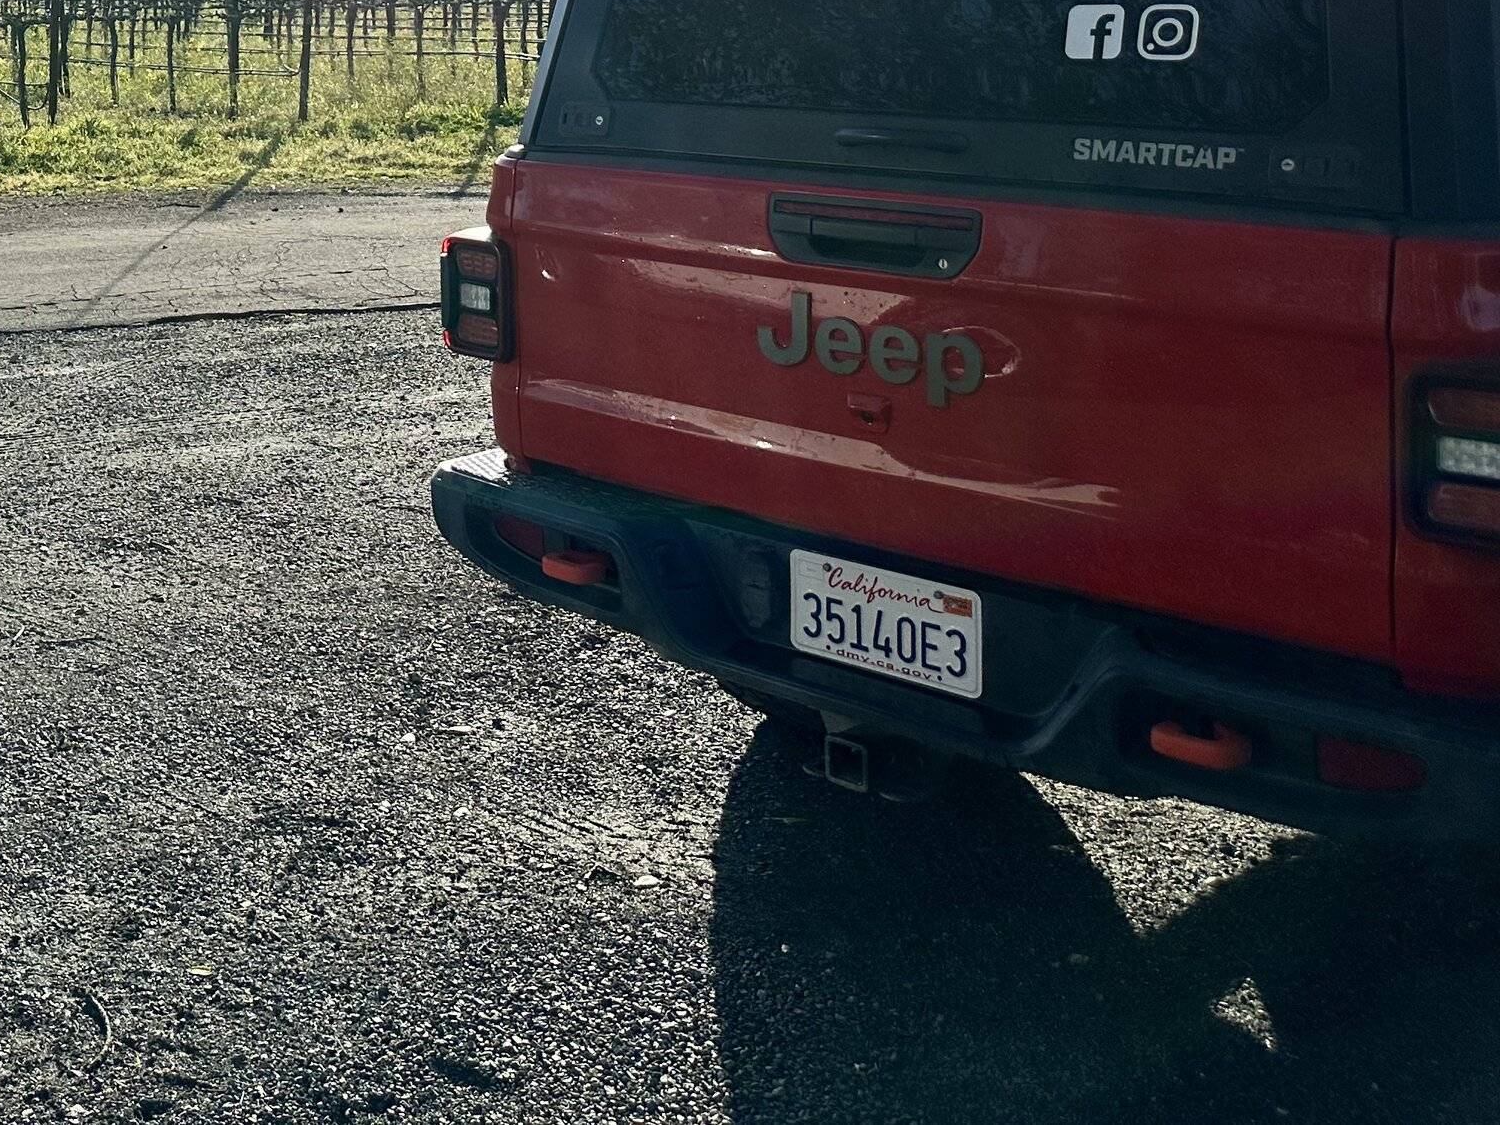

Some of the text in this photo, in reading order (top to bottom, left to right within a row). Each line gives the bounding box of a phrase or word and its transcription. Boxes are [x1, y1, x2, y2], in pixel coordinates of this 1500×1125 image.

[756, 290, 986, 409] Jeep
[827, 566, 944, 614] California
[803, 592, 967, 678] 35140E3
[836, 648, 933, 682] dmv.ca.gov
